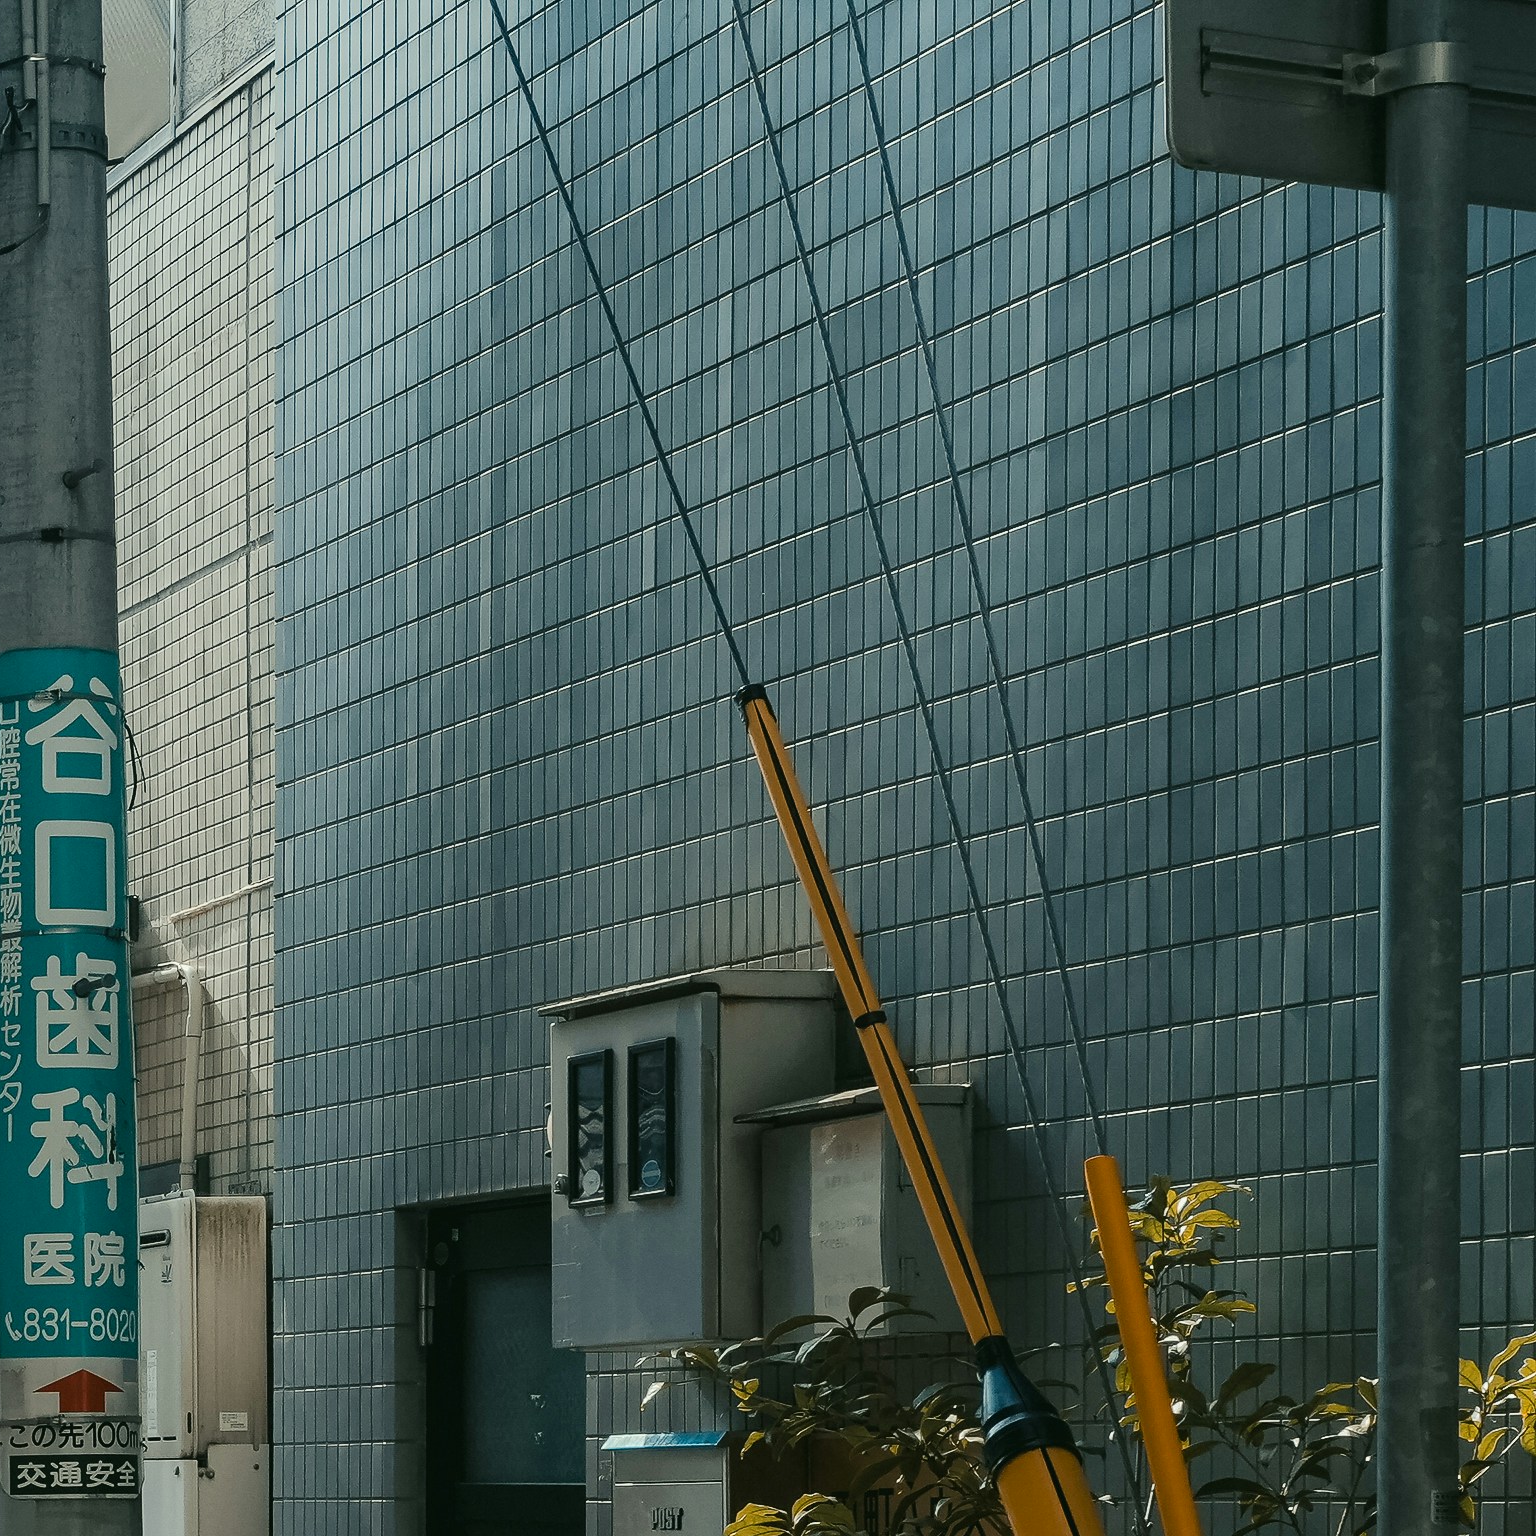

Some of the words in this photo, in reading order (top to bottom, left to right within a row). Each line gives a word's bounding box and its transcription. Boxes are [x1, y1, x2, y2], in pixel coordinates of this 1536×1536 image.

[24, 673, 125, 1211] 谷口歯科
[24, 1230, 126, 1288] 医院
[23, 1307, 137, 1342] 831-8020
[9, 1421, 139, 1449] この先100m
[16, 1460, 136, 1489] 交通安全
[651, 1507, 685, 1531] POST
